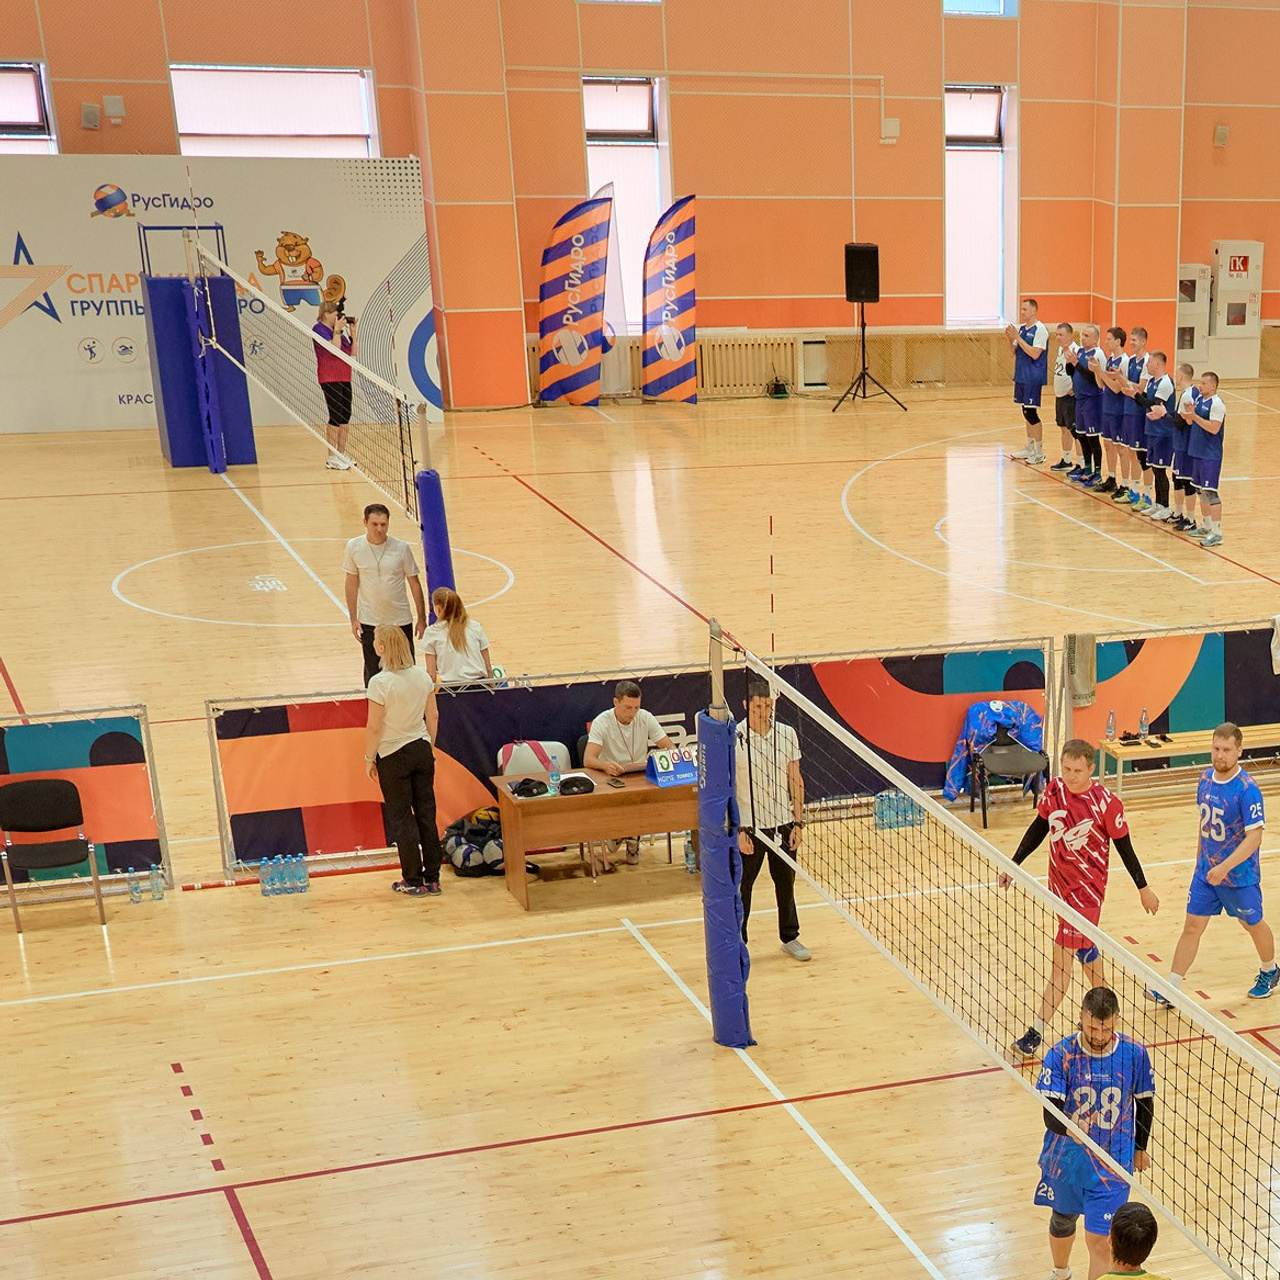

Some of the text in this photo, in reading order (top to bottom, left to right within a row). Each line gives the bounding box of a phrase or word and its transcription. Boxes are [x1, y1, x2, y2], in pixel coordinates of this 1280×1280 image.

[131, 193, 214, 211] РусГидро
[562, 233, 586, 326] РусГидро
[662, 231, 679, 322] РусГидро
[1230, 256, 1245, 271] ПК
[1200, 802, 1226, 842] 25
[1071, 1086, 1122, 1131] 28
[1037, 1182, 1055, 1201] 28
